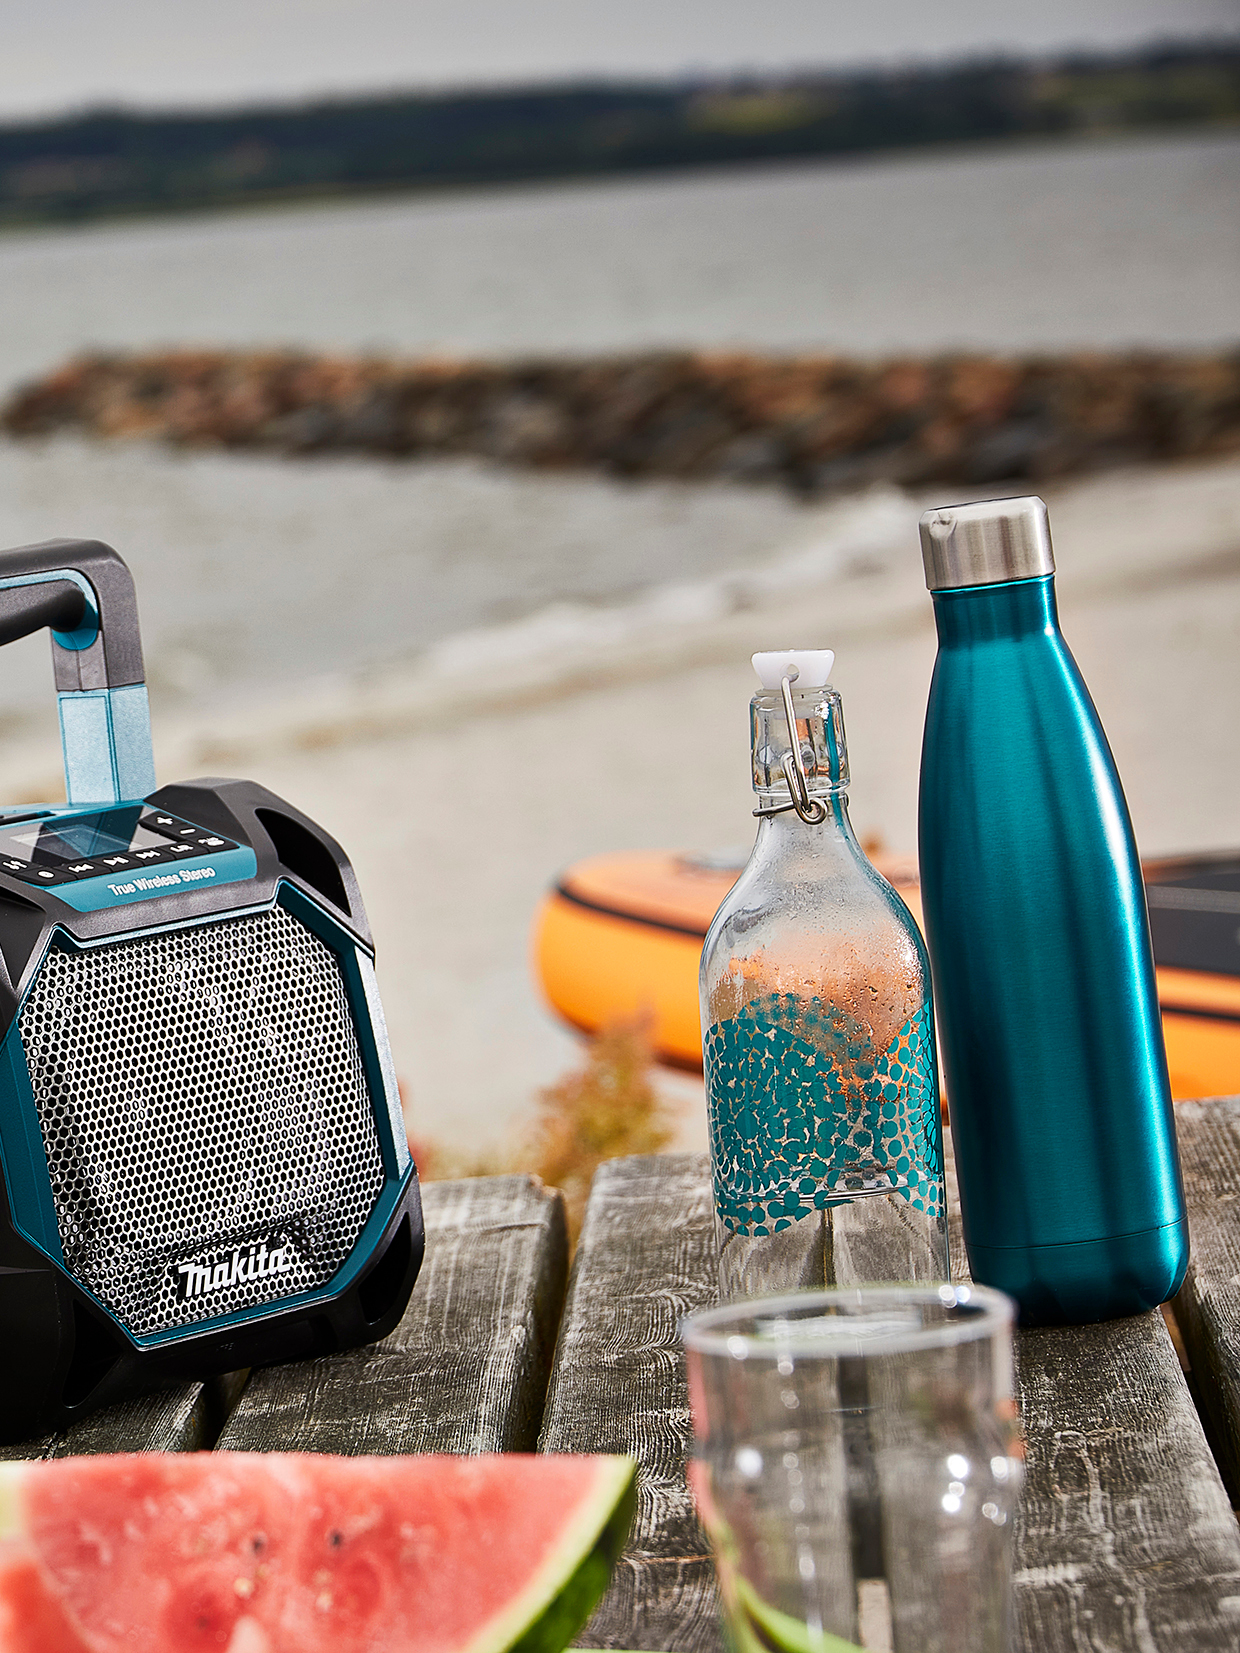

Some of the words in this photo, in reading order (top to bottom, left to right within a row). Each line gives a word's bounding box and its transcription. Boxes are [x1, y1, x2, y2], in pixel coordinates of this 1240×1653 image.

[107, 882, 136, 896] True
[133, 873, 181, 891] Wireless
[178, 867, 216, 882] Stereo
